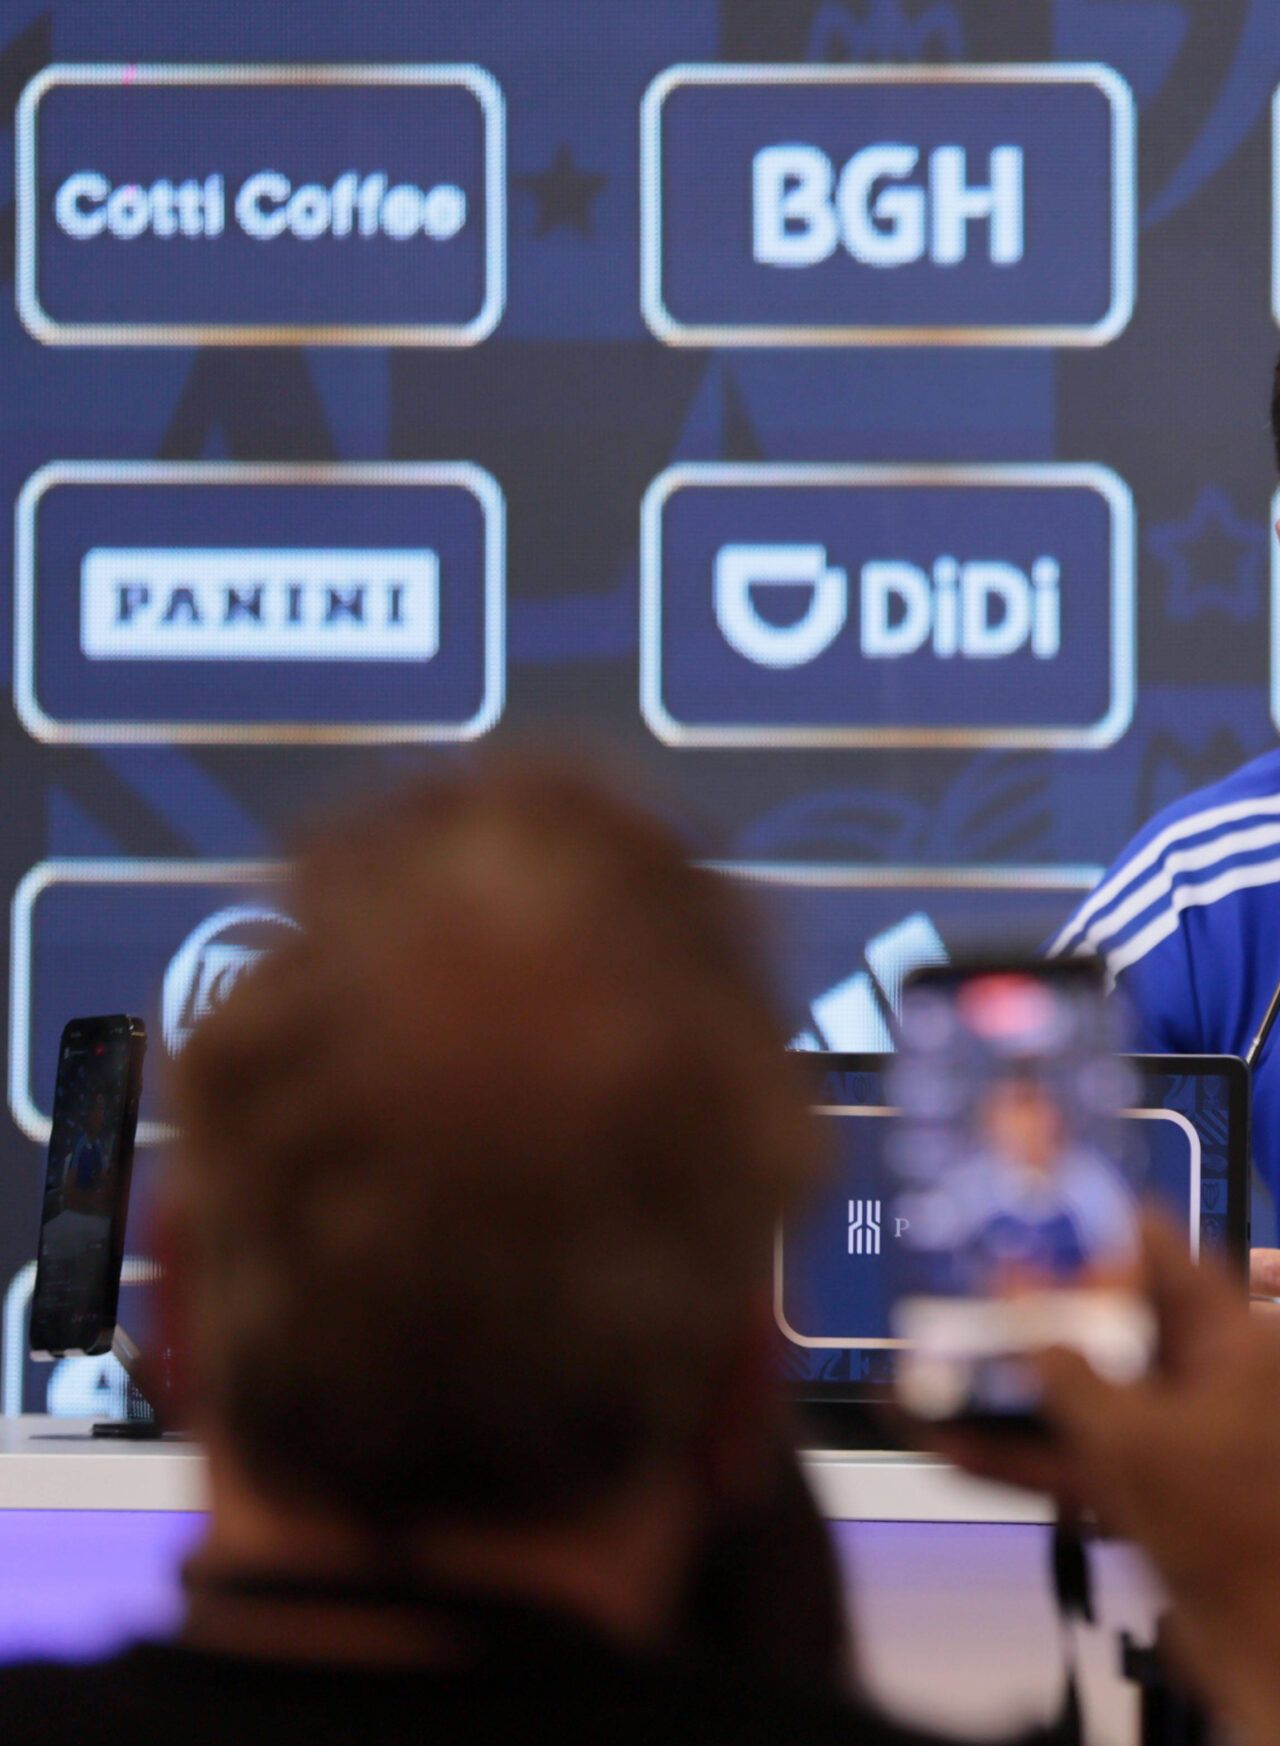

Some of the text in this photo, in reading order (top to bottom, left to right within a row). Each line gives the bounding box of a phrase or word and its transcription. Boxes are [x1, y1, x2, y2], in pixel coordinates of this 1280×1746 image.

[56, 168, 466, 240] Cotti Coffee
[752, 143, 1024, 267] BGH
[116, 580, 404, 624] PANINI
[861, 555, 1061, 660] DiDi
